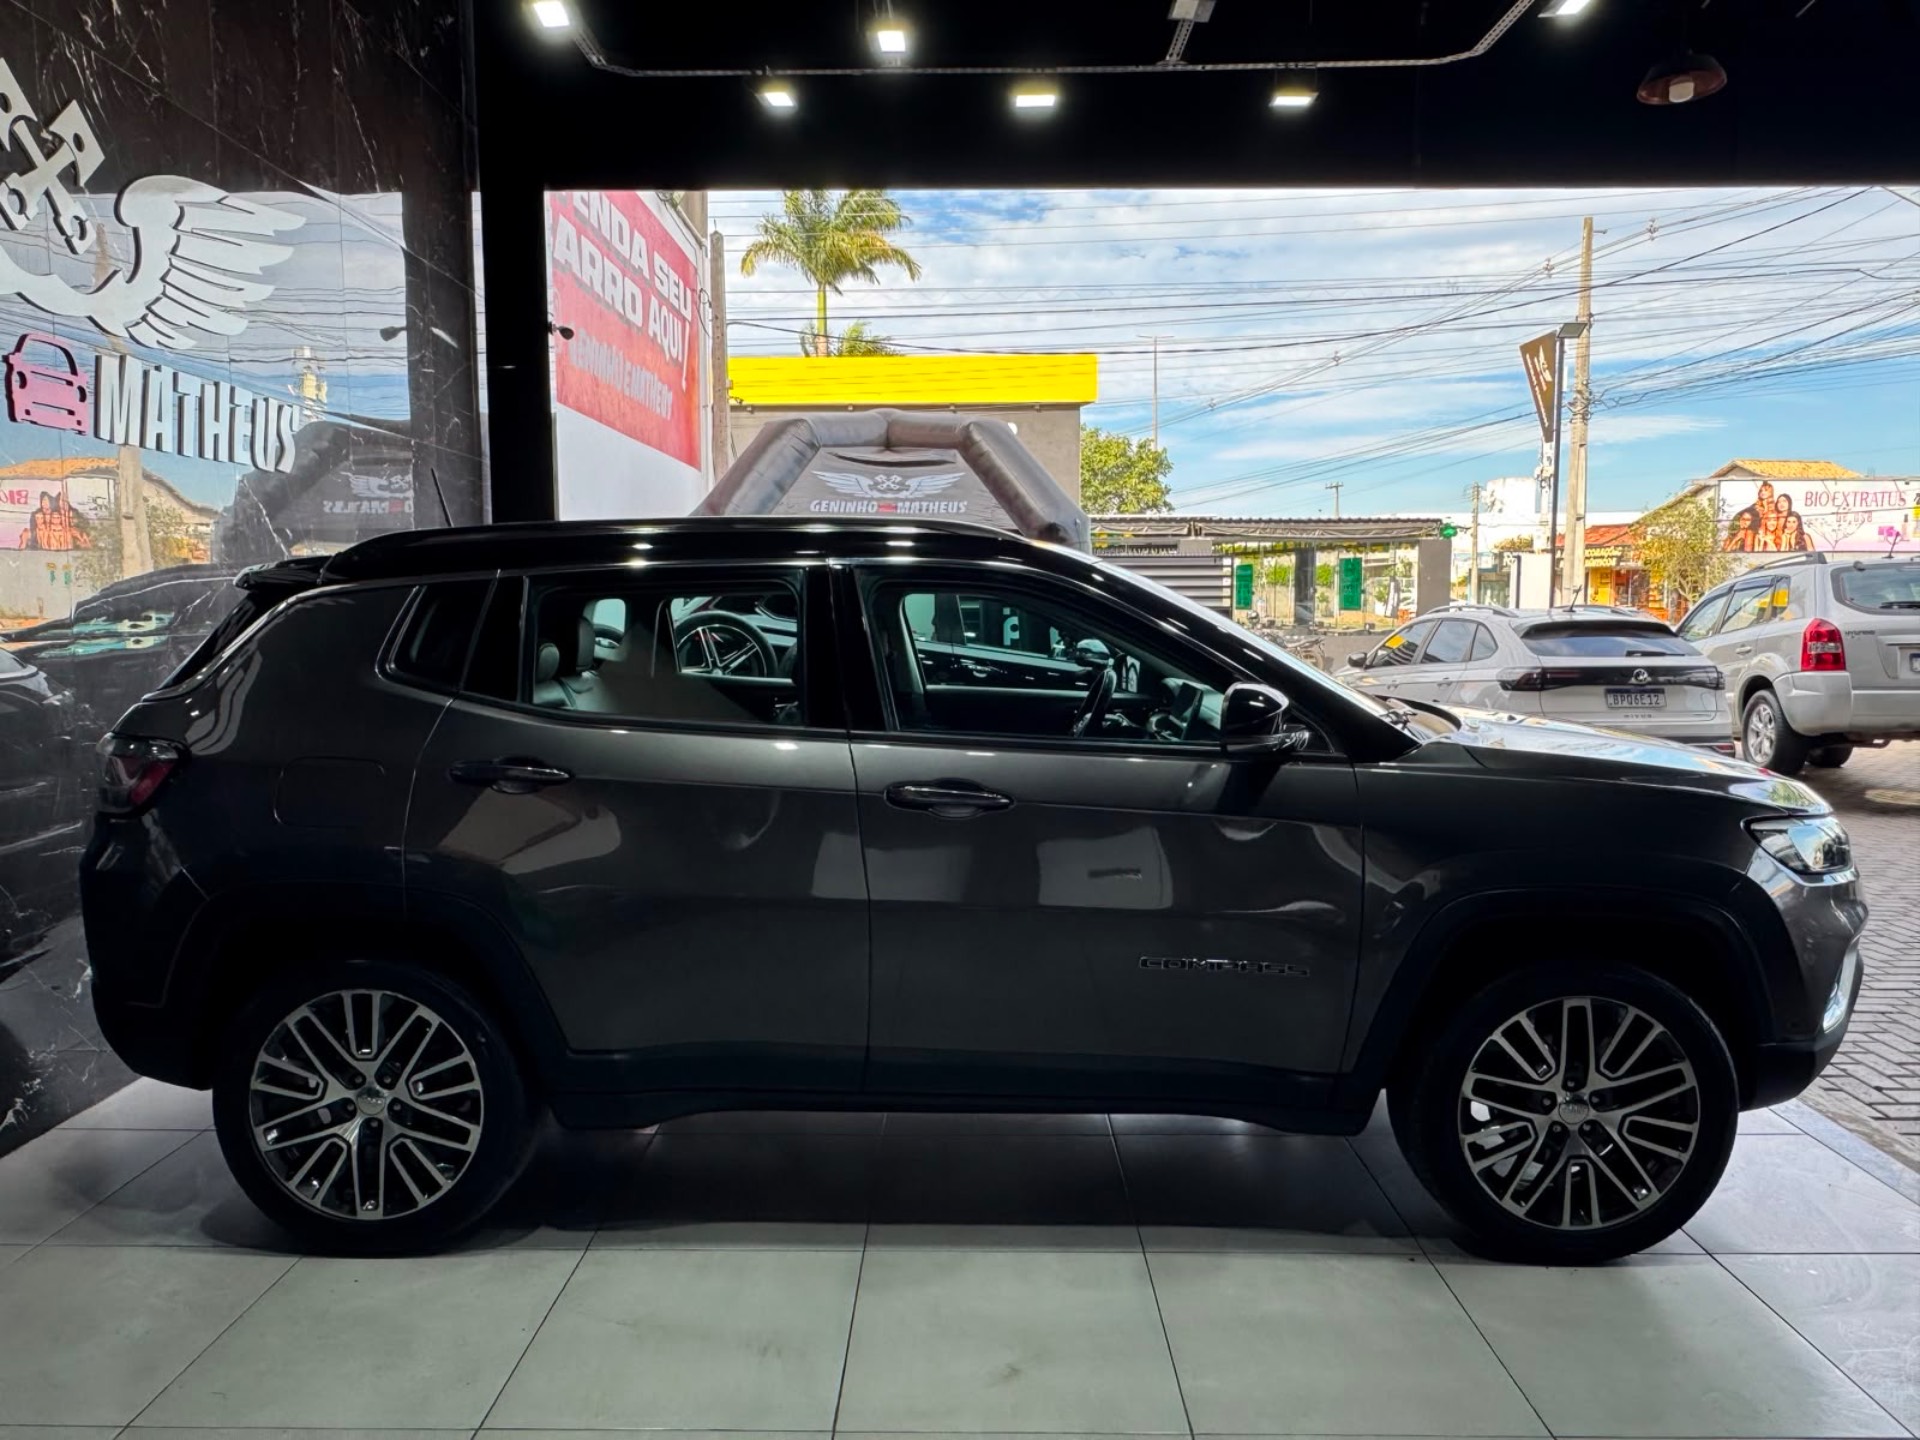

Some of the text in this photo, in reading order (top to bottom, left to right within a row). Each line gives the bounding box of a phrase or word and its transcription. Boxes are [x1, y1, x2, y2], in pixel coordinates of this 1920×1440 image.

[558, 192, 692, 322] ENDA SEU
[95, 354, 300, 474] MATHEUS
[809, 500, 967, 514] GENINHO MATHEUS
[1139, 956, 1310, 977] COMPASS
